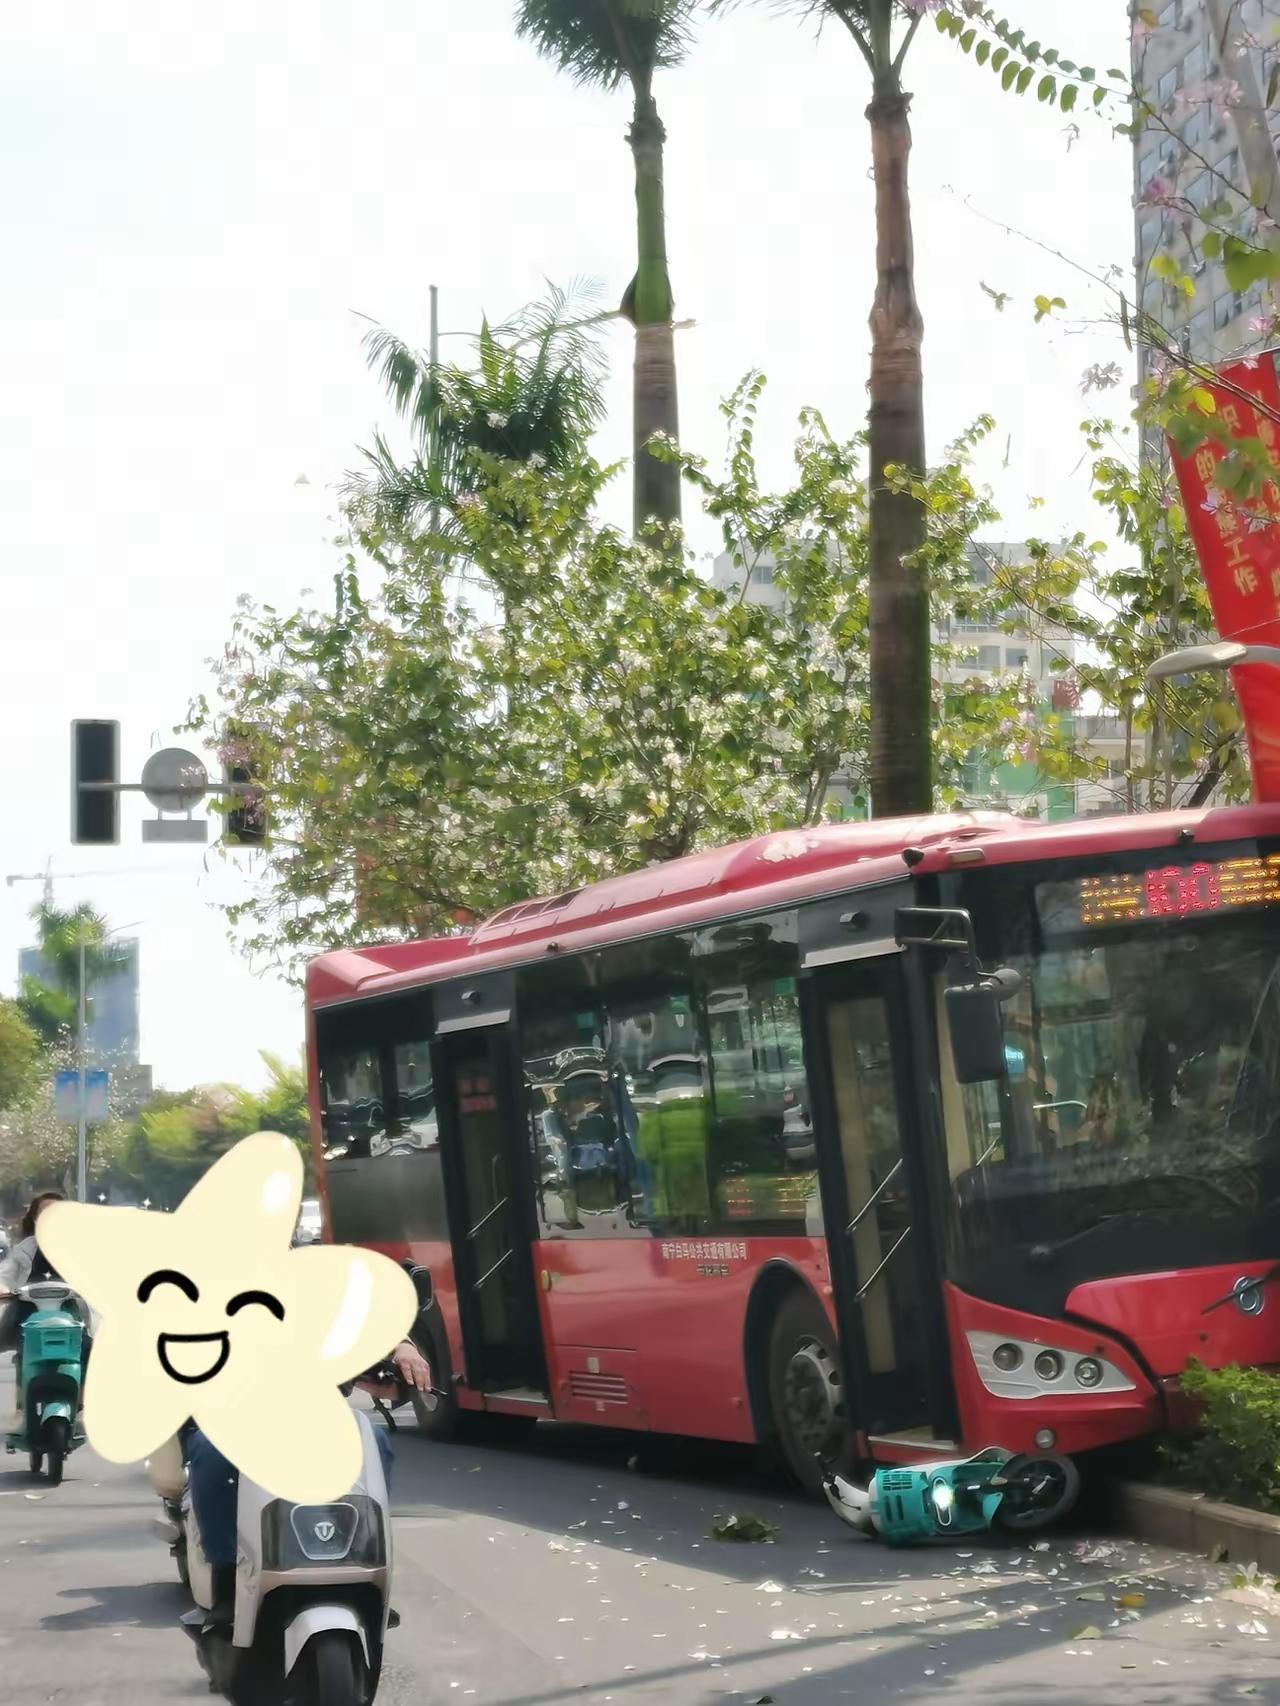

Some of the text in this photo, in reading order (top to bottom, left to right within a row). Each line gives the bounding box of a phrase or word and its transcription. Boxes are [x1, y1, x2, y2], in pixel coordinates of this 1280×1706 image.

[661, 1241, 747, 1260] 南宁白马公共交通有限公司
